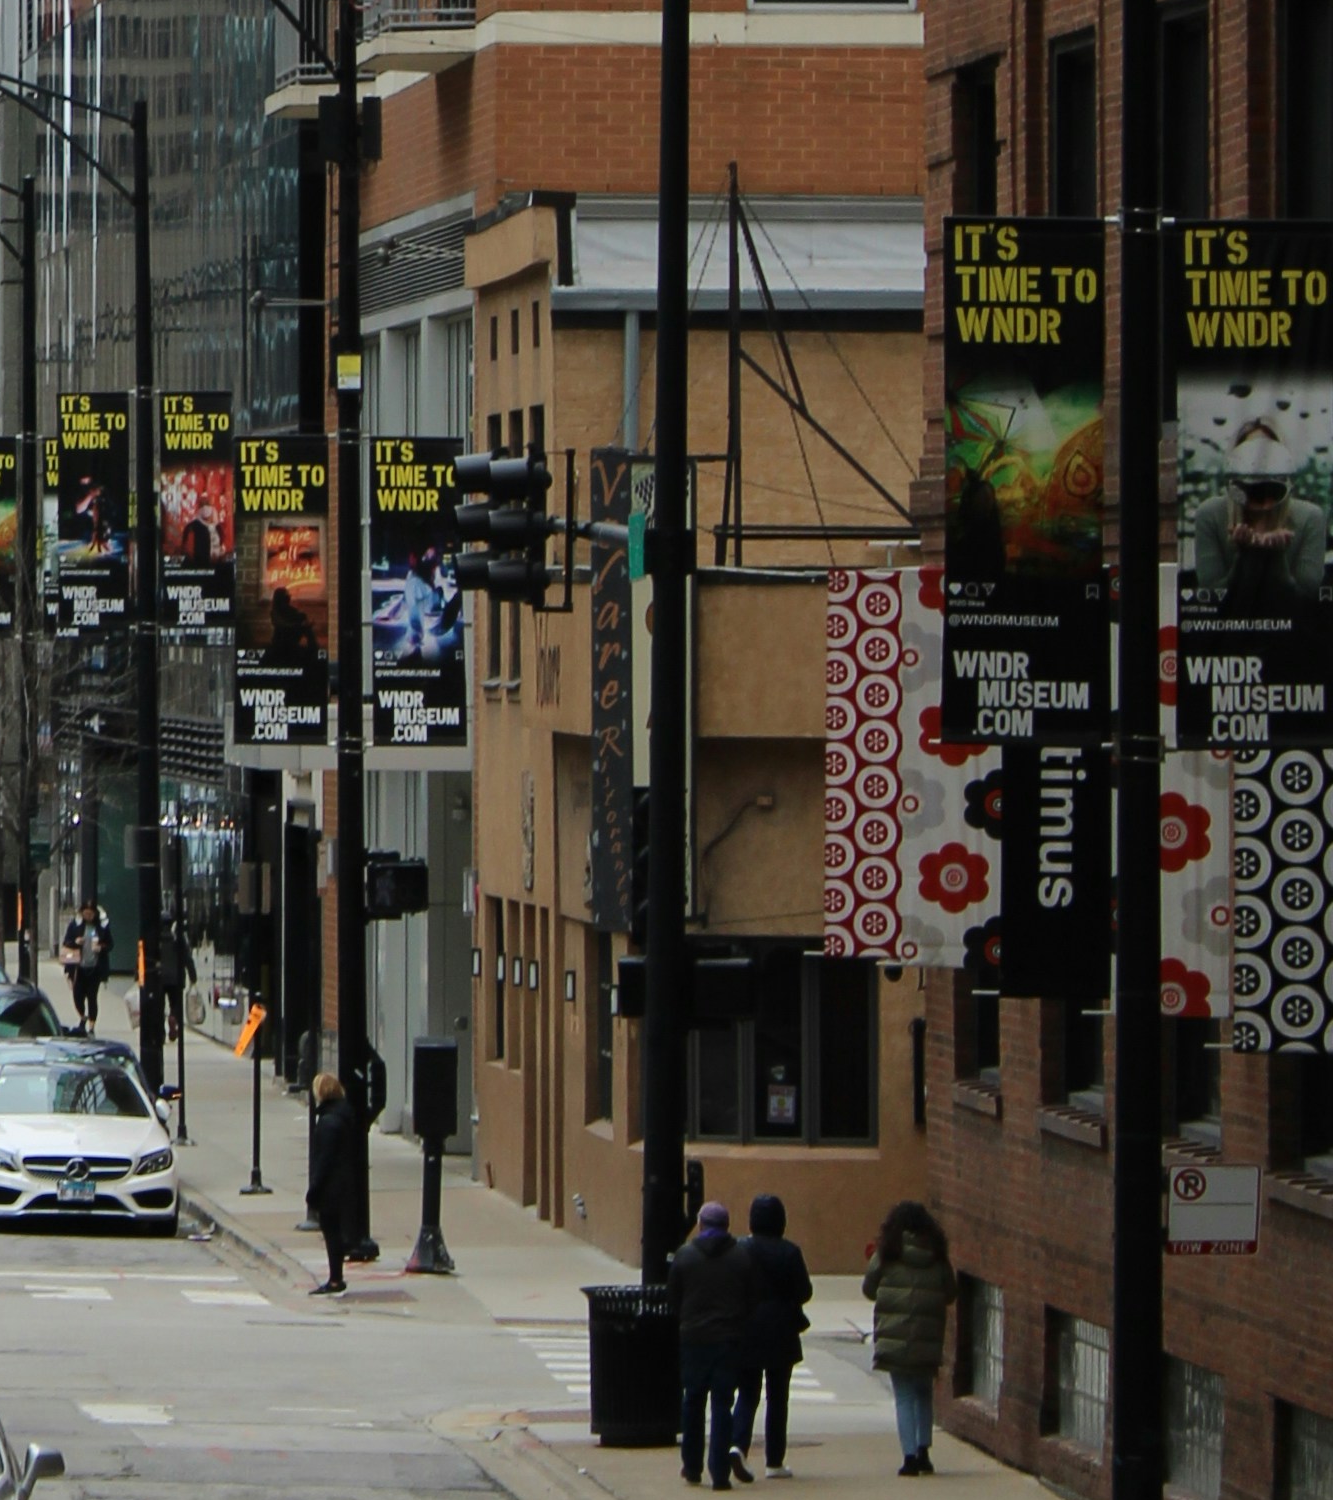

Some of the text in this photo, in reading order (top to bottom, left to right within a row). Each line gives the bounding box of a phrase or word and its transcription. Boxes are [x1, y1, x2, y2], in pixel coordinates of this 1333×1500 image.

[954, 223, 1019, 261] IT'S
[1185, 227, 1249, 265] IT'S
[955, 266, 1097, 304] TIME TO
[1185, 269, 1327, 306] TIME TO
[955, 306, 1062, 344] WNDR
[1186, 311, 1292, 347] WNDR
[60, 395, 91, 413] IT'S
[163, 395, 194, 413] IT'S
[61, 413, 126, 431] TIME TO
[164, 414, 229, 431] TIME TO
[62, 432, 111, 449] WNDR
[164, 432, 214, 450] WNDR
[239, 440, 280, 463] IT'S
[375, 440, 414, 463] IT'S
[241, 464, 326, 487] TIME TO
[376, 464, 455, 487] TIME TO
[242, 488, 304, 512] WNDR
[377, 488, 439, 512] WNDR
[279, 544, 298, 561] all
[62, 585, 97, 600] WNDR
[166, 585, 202, 600] WNDR
[73, 599, 124, 612] MUSEUM
[179, 599, 230, 612] MUSEUM
[948, 614, 1060, 627] @WNDRMUSEUM
[1181, 619, 1293, 632] @WNDRMUSEUM
[953, 650, 1030, 680] WNDR
[1185, 655, 1263, 685] WNDR
[240, 689, 285, 706] WNDR
[378, 690, 424, 708] WNDR
[977, 680, 1090, 710] MUSEUM
[1211, 684, 1325, 713] MUSEUM
[255, 706, 321, 723] MUSEUM
[393, 707, 460, 725] MUSEUM
[972, 709, 1033, 737] .COM
[251, 723, 288, 740] .COM
[391, 725, 427, 742] .COM
[1207, 713, 1269, 742] .COM
[1037, 746, 1087, 909] timus
[1173, 1242, 1201, 1253] TOW
